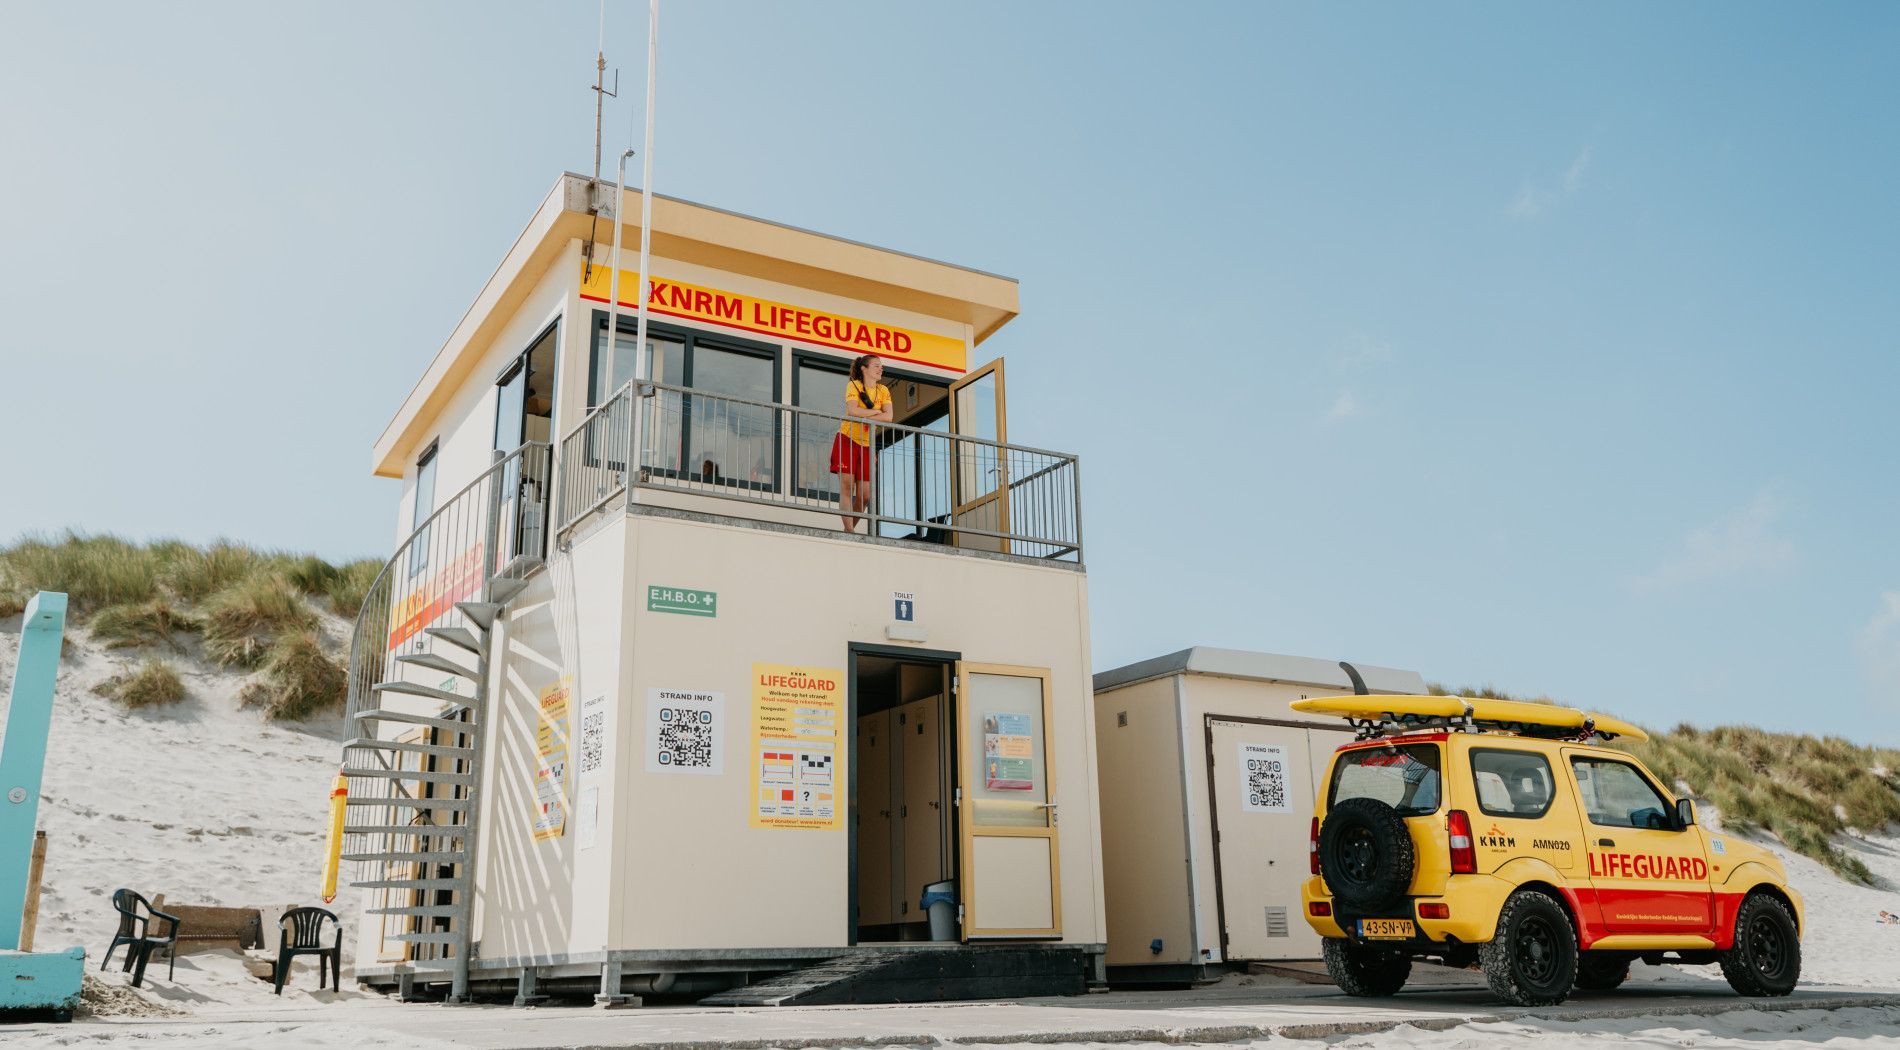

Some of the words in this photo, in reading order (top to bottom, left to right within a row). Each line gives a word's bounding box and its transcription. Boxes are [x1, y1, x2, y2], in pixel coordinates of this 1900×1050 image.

[649, 281, 742, 321] KNRM
[754, 302, 912, 353] LIFEGUARD
[651, 589, 700, 604] E.H.B.O.
[894, 592, 914, 600] TOILET
[760, 674, 836, 692] LIFEGUARD
[660, 692, 692, 701] STRAND
[1480, 836, 1516, 848] KNRM
[1533, 839, 1571, 851] AMN020
[1588, 852, 1708, 881] LIFEGUARD
[1366, 921, 1412, 935] 43-SN-VP
